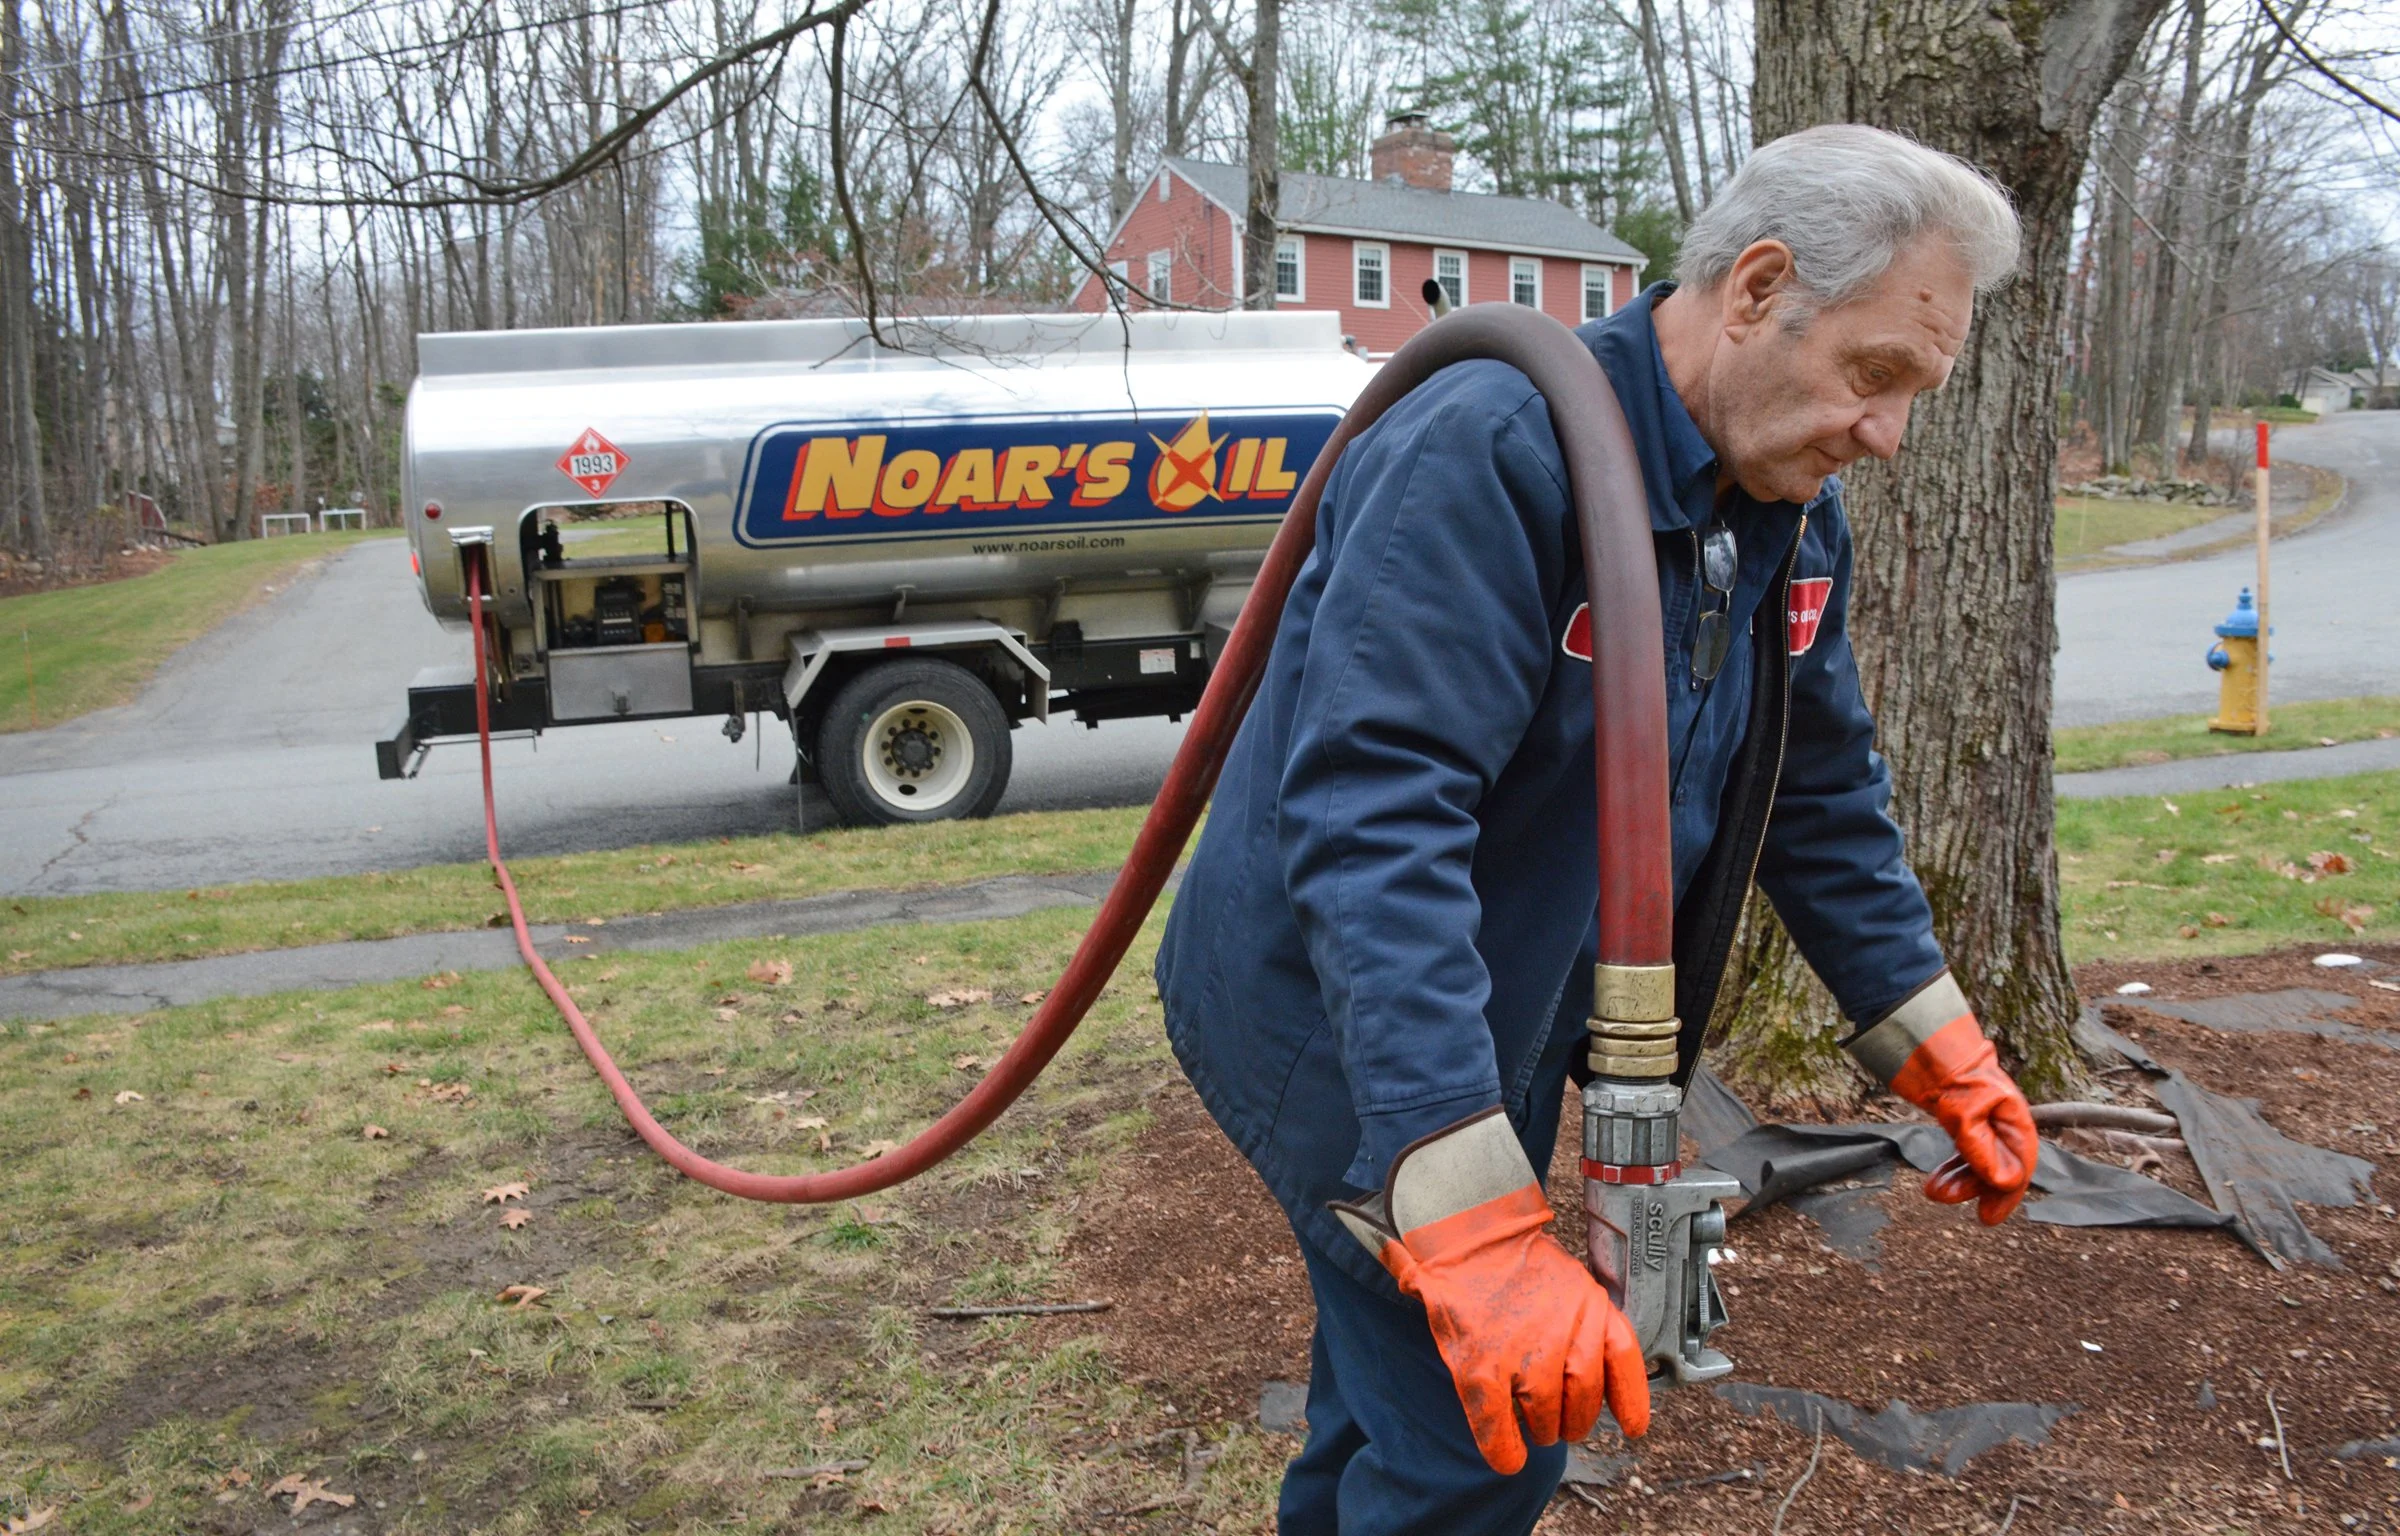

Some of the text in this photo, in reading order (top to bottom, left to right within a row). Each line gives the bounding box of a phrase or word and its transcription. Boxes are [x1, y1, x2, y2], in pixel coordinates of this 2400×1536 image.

[574, 454, 613, 475] 1993
[783, 435, 1135, 520] NOAR'S
[972, 536, 1125, 555] www.noarsoil.com
[1632, 1243, 1641, 1275] NOZZLE
